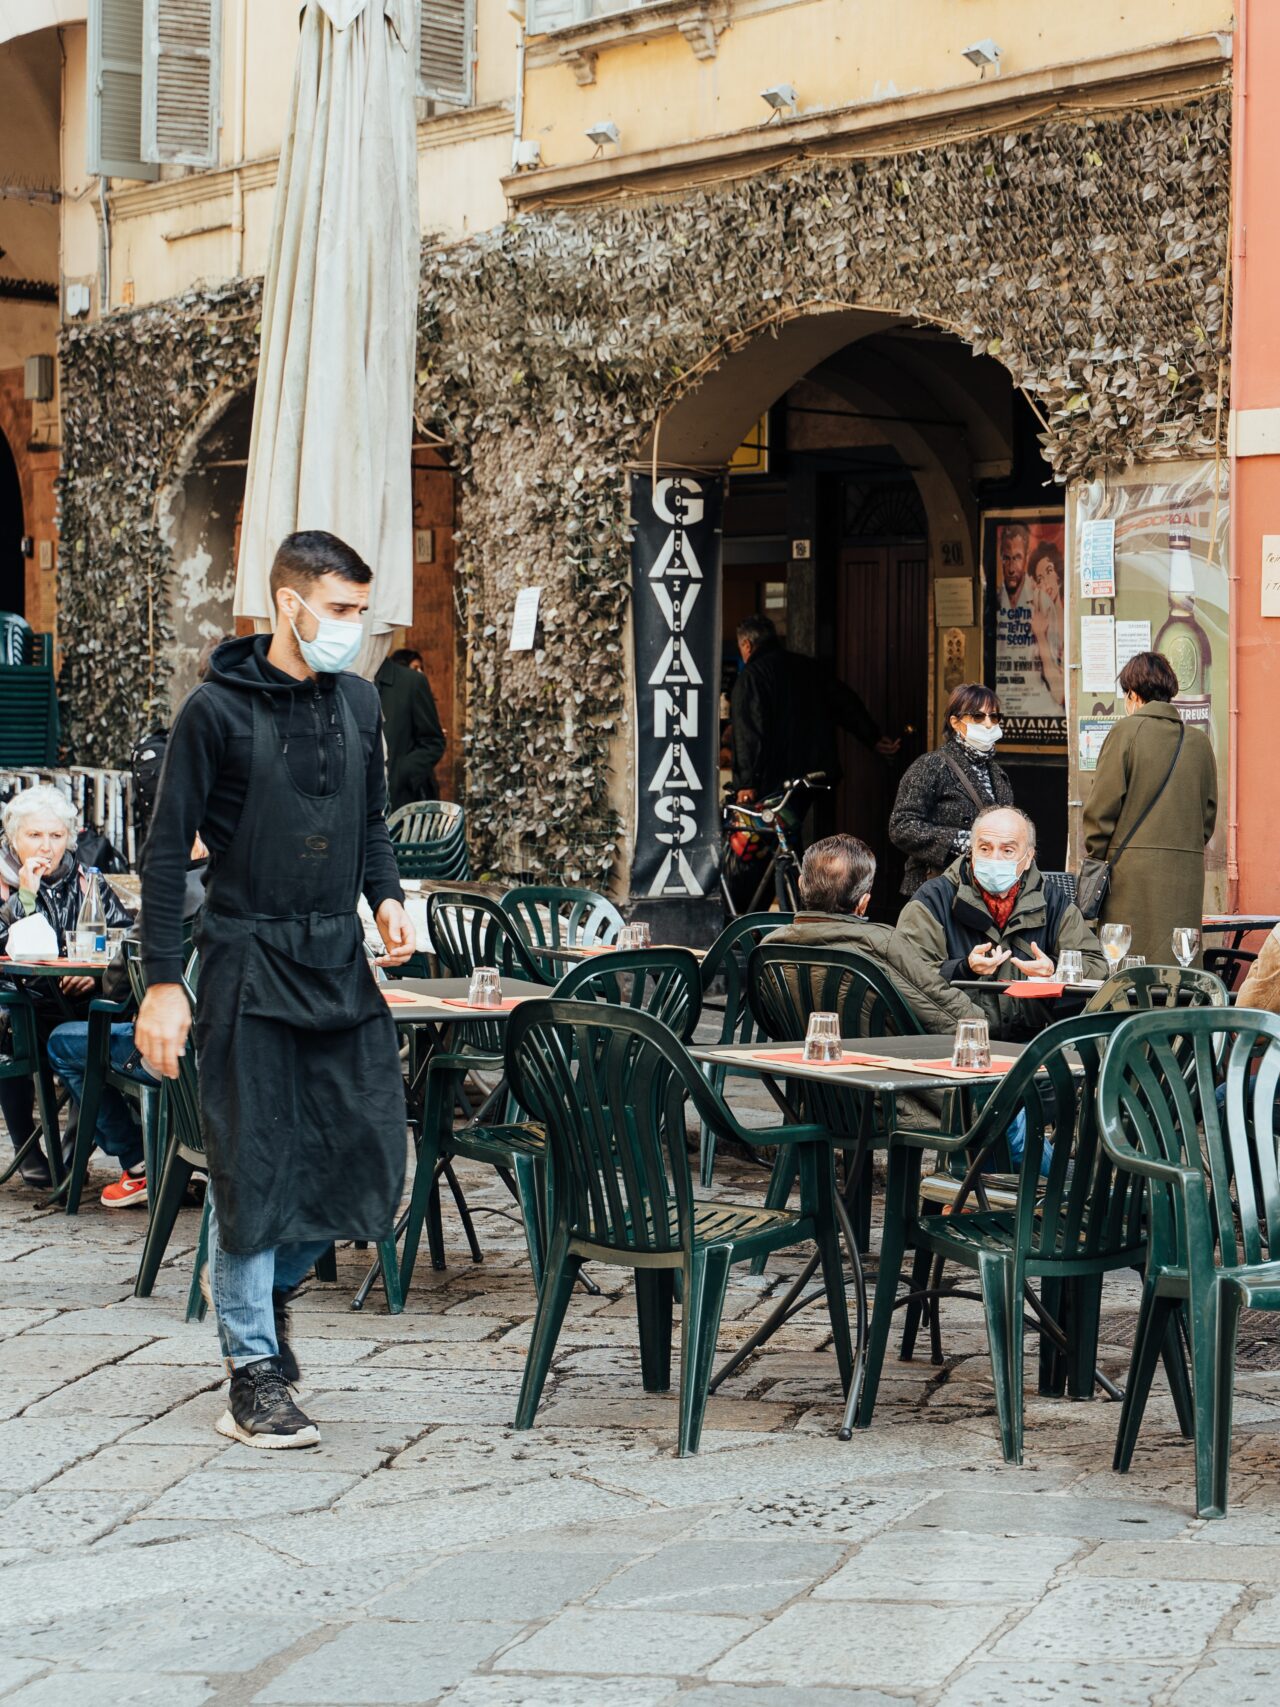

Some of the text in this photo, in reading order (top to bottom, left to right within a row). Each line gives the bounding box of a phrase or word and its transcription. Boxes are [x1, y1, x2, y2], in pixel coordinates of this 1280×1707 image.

[647, 477, 705, 897] GAVANASA
[672, 478, 682, 859] MOVIDA HOUSE PARMA CITY
[1180, 708, 1209, 720] TREUSE
